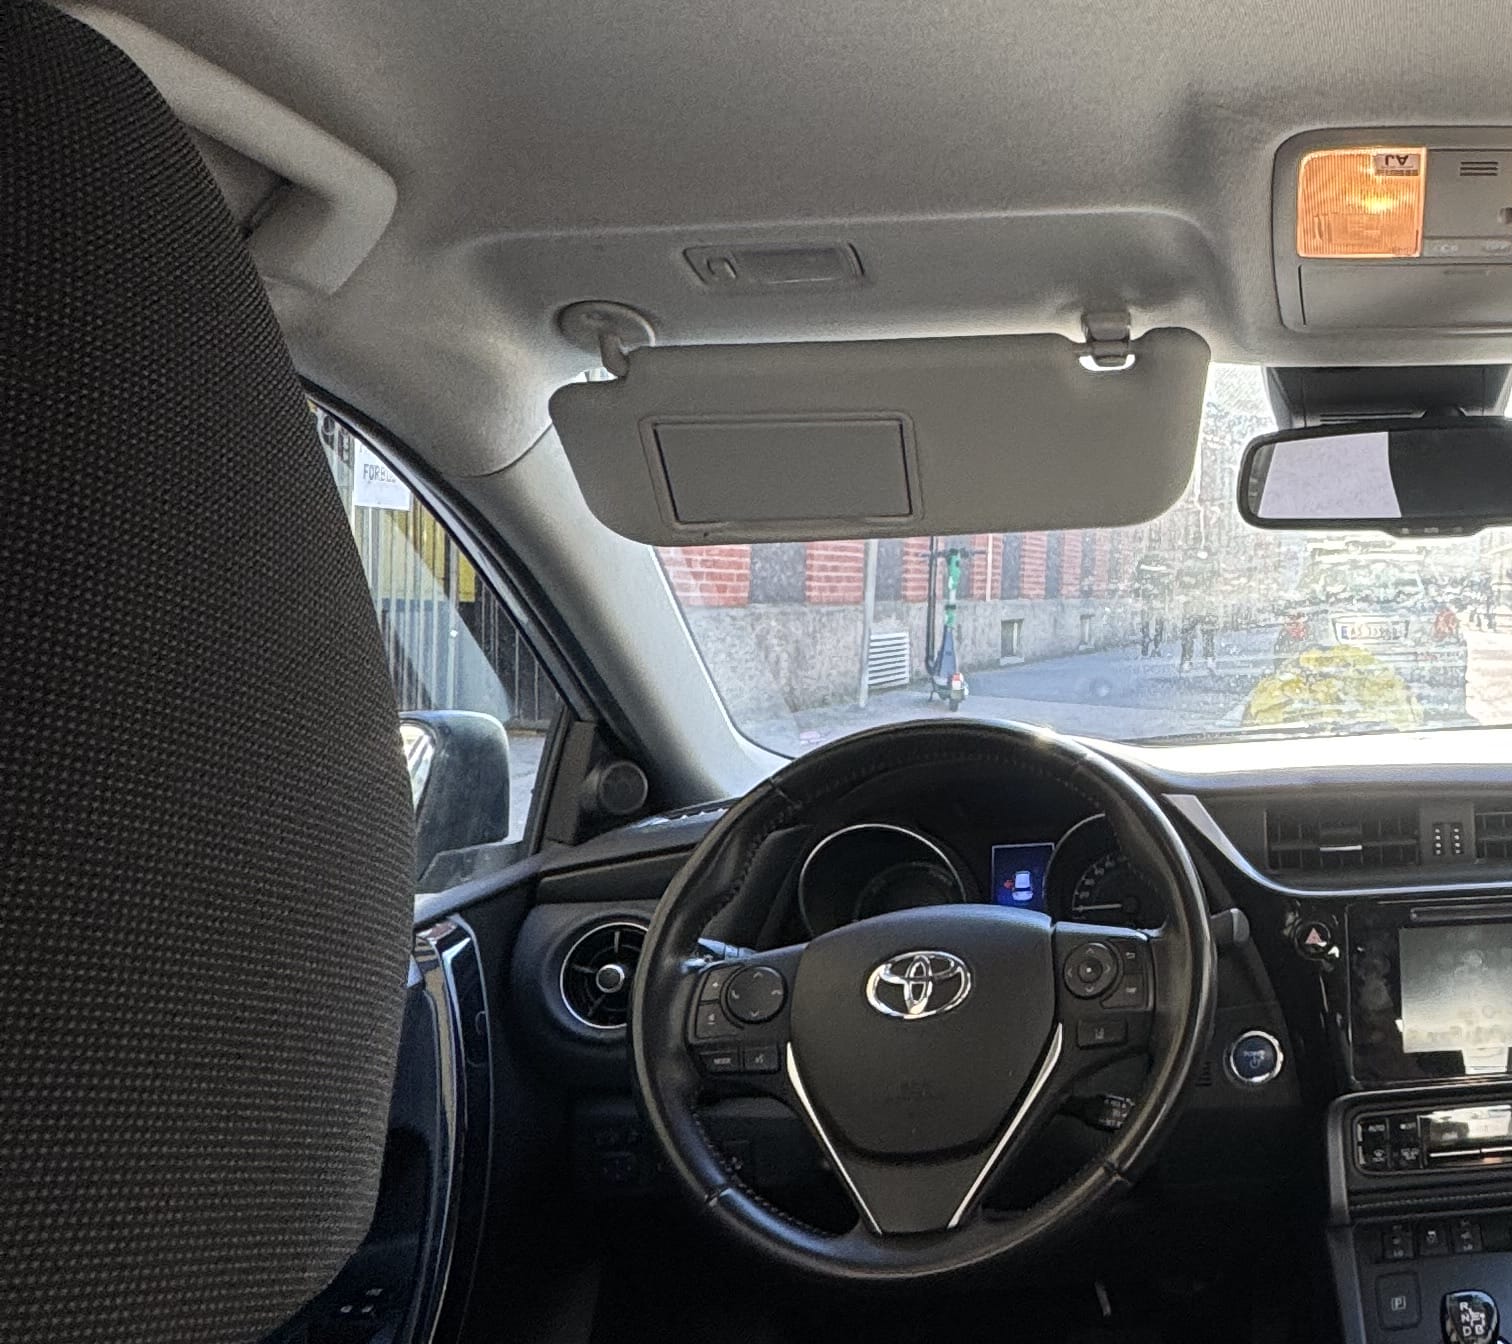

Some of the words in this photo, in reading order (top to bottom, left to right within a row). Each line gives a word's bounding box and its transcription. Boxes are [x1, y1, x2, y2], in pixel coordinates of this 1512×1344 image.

[1459, 1301, 1469, 1311] R
[1460, 1312, 1470, 1324] N
[1462, 1325, 1472, 1337] D
[1475, 1324, 1485, 1336] B
